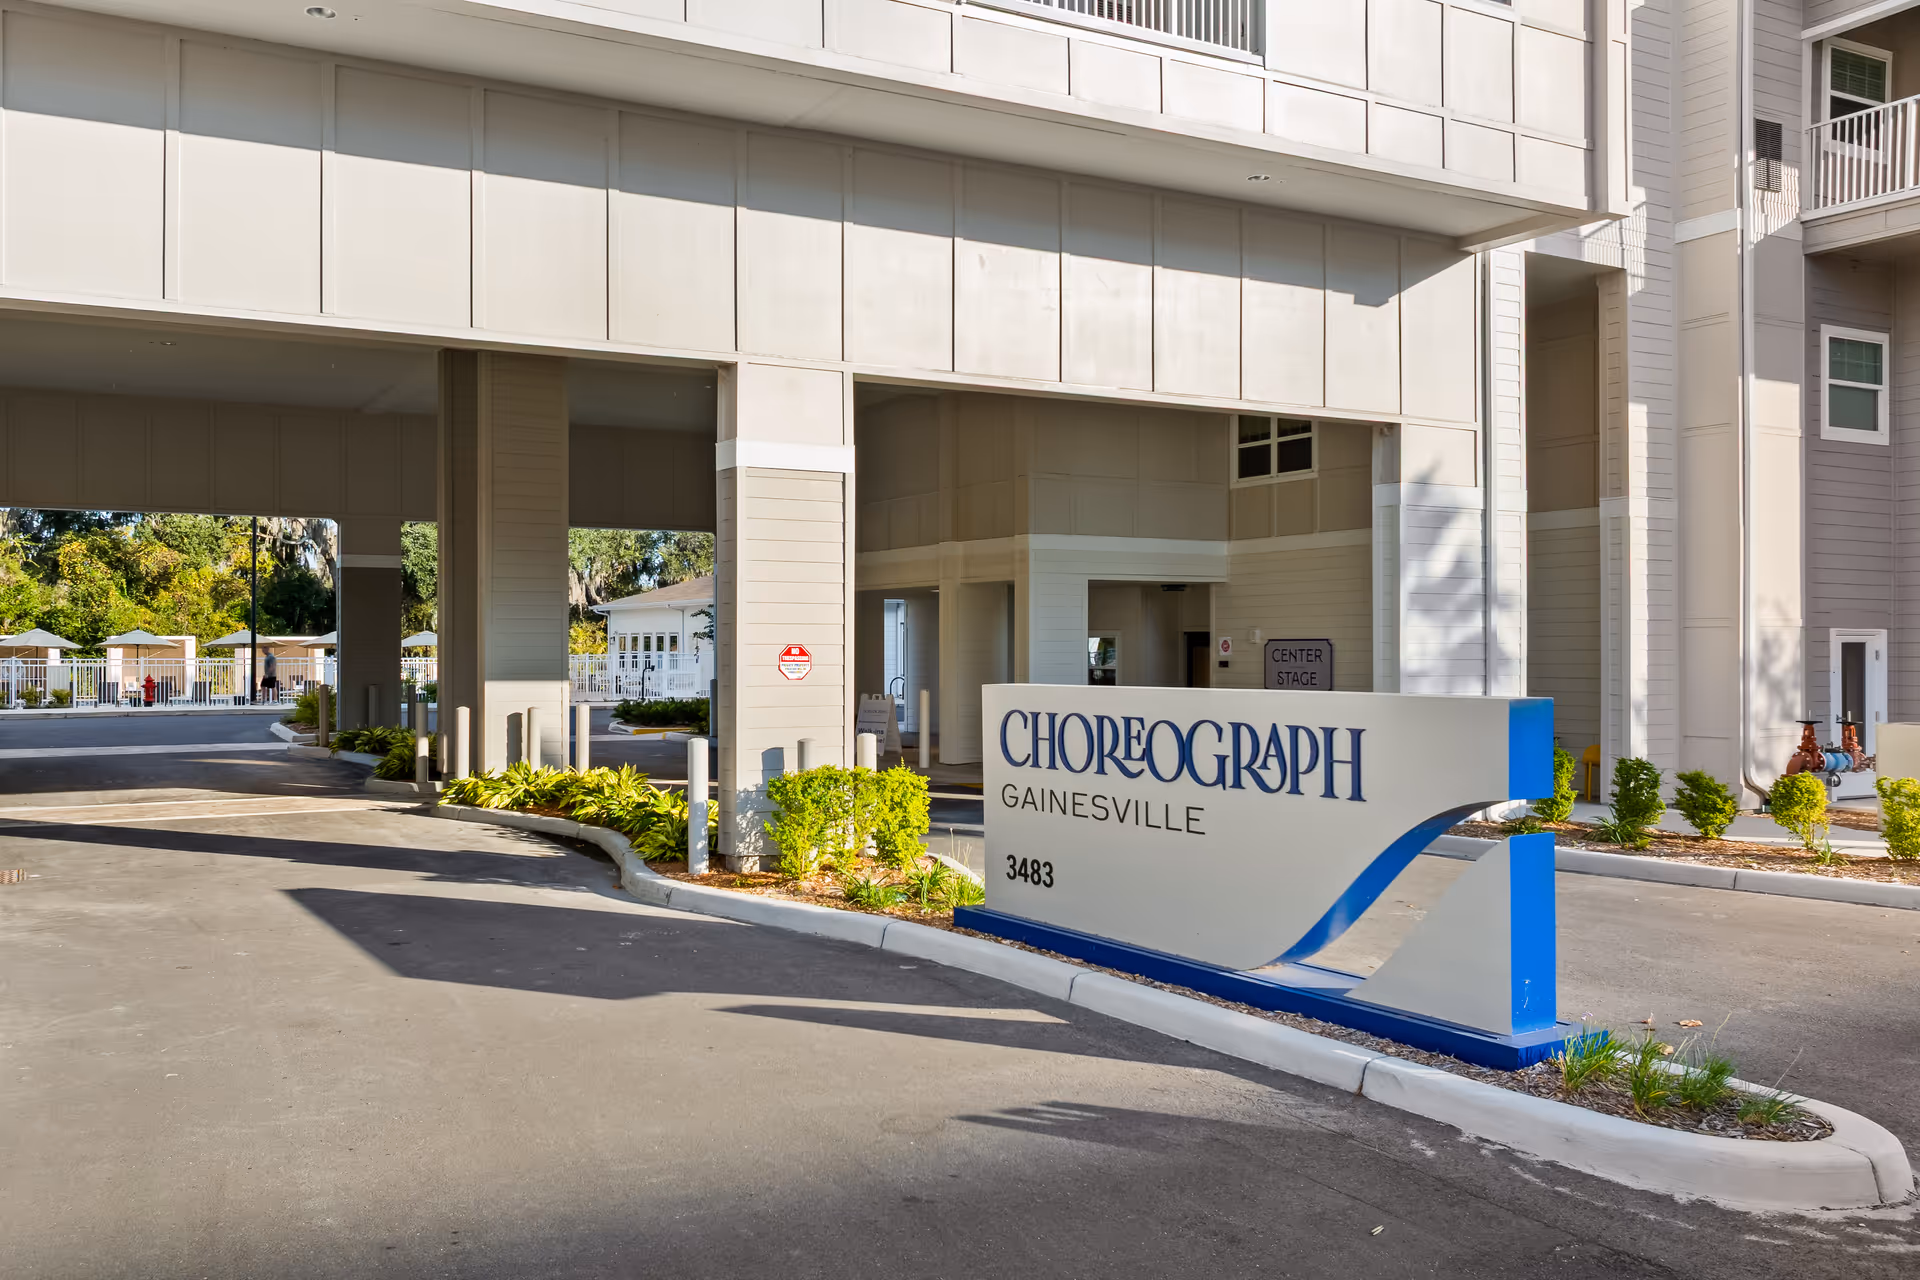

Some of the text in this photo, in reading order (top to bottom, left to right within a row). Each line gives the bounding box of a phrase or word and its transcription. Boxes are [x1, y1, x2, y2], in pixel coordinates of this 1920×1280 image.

[1271, 648, 1323, 663] CENTER
[1277, 671, 1318, 686] STAGE
[1000, 709, 1367, 802] CHOREOGRAPH
[1001, 784, 1206, 835] GAINESVILLE
[1006, 854, 1054, 888] 3483
